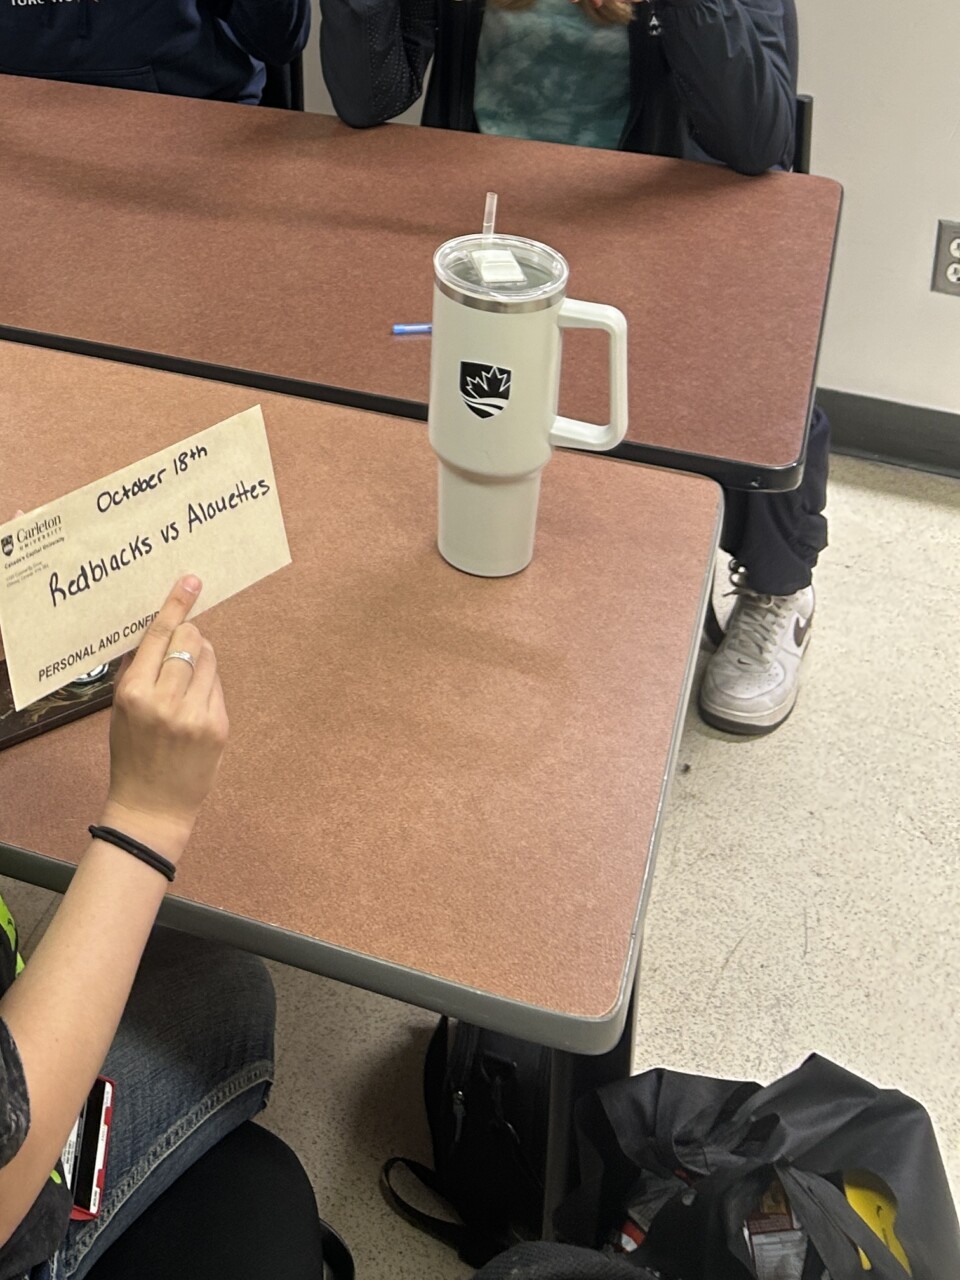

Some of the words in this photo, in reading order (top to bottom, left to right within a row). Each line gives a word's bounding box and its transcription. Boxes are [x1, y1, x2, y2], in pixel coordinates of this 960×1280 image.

[96, 467, 167, 513] October
[172, 445, 208, 476] 18th
[16, 514, 62, 544] Carleton
[19, 526, 62, 550] UNIVERSITY
[49, 535, 153, 608] Redblacks
[161, 522, 179, 545] vs
[188, 478, 271, 533] Alouettes
[38, 642, 97, 682] PERSONAL
[98, 630, 121, 653] AND
